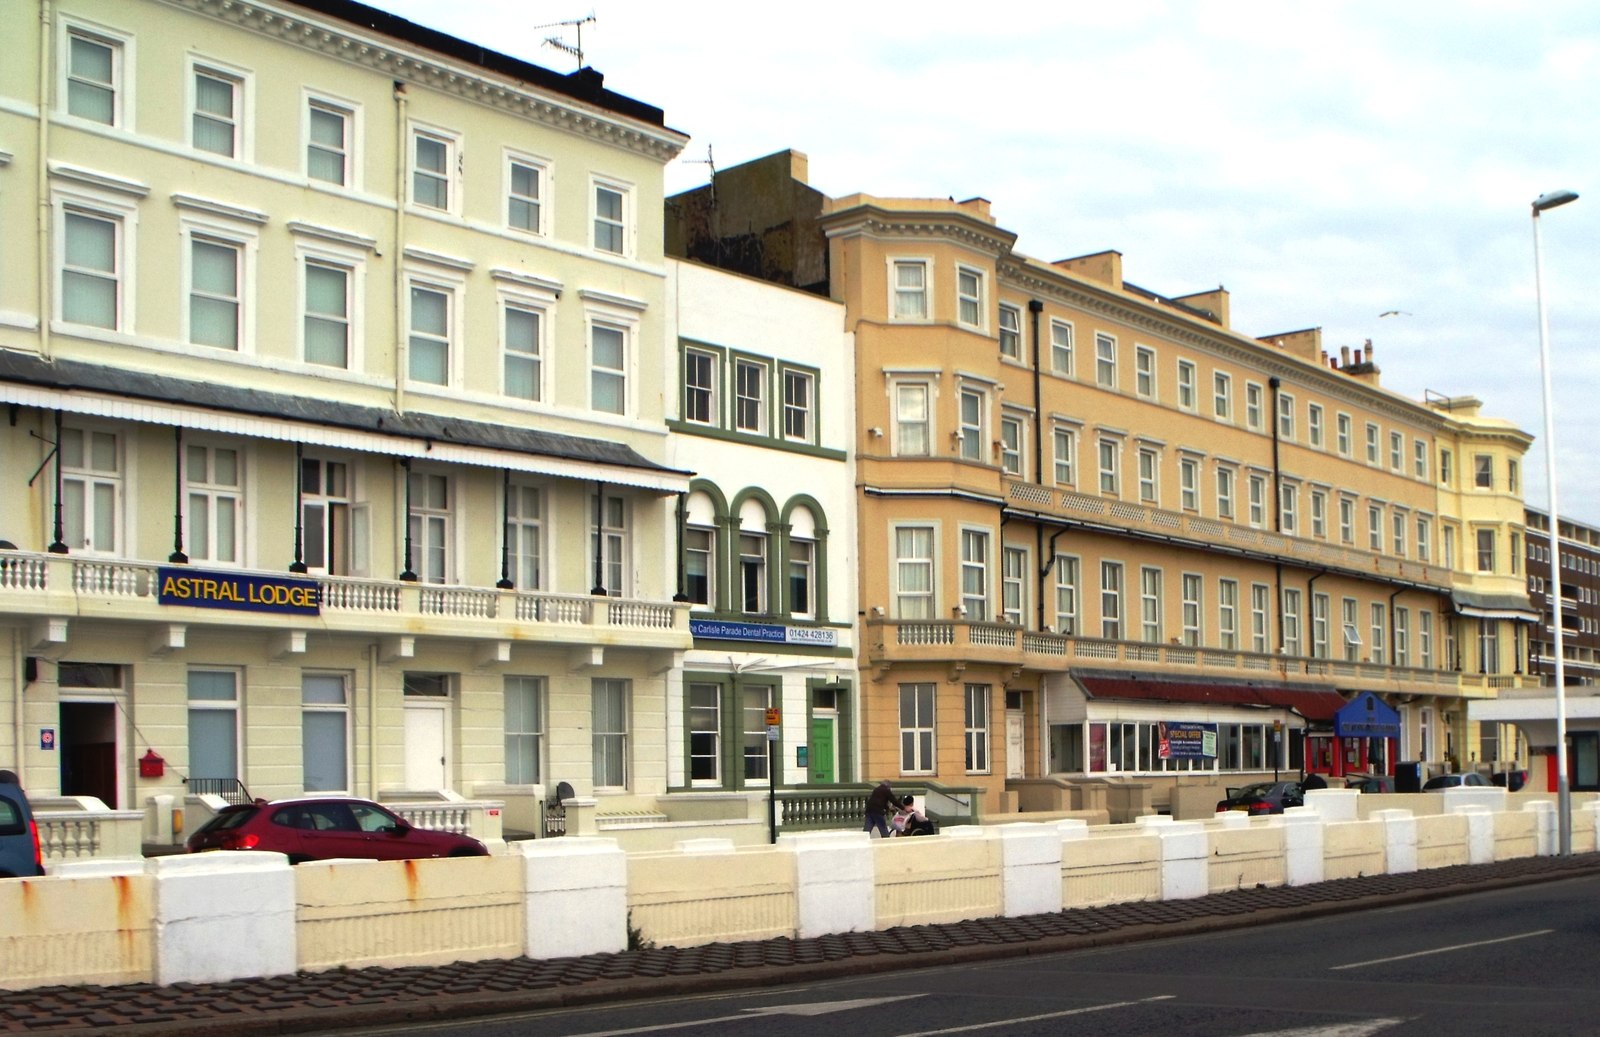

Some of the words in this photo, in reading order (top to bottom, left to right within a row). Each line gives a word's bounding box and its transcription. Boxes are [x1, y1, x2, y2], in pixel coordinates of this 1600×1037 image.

[162, 576, 245, 602] ASTRAL
[250, 583, 318, 607] LODGE
[698, 624, 720, 634] Carlisle
[721, 626, 742, 635] Parade
[743, 627, 762, 637] Dental
[762, 629, 785, 638] Practice
[790, 629, 809, 638] 01424
